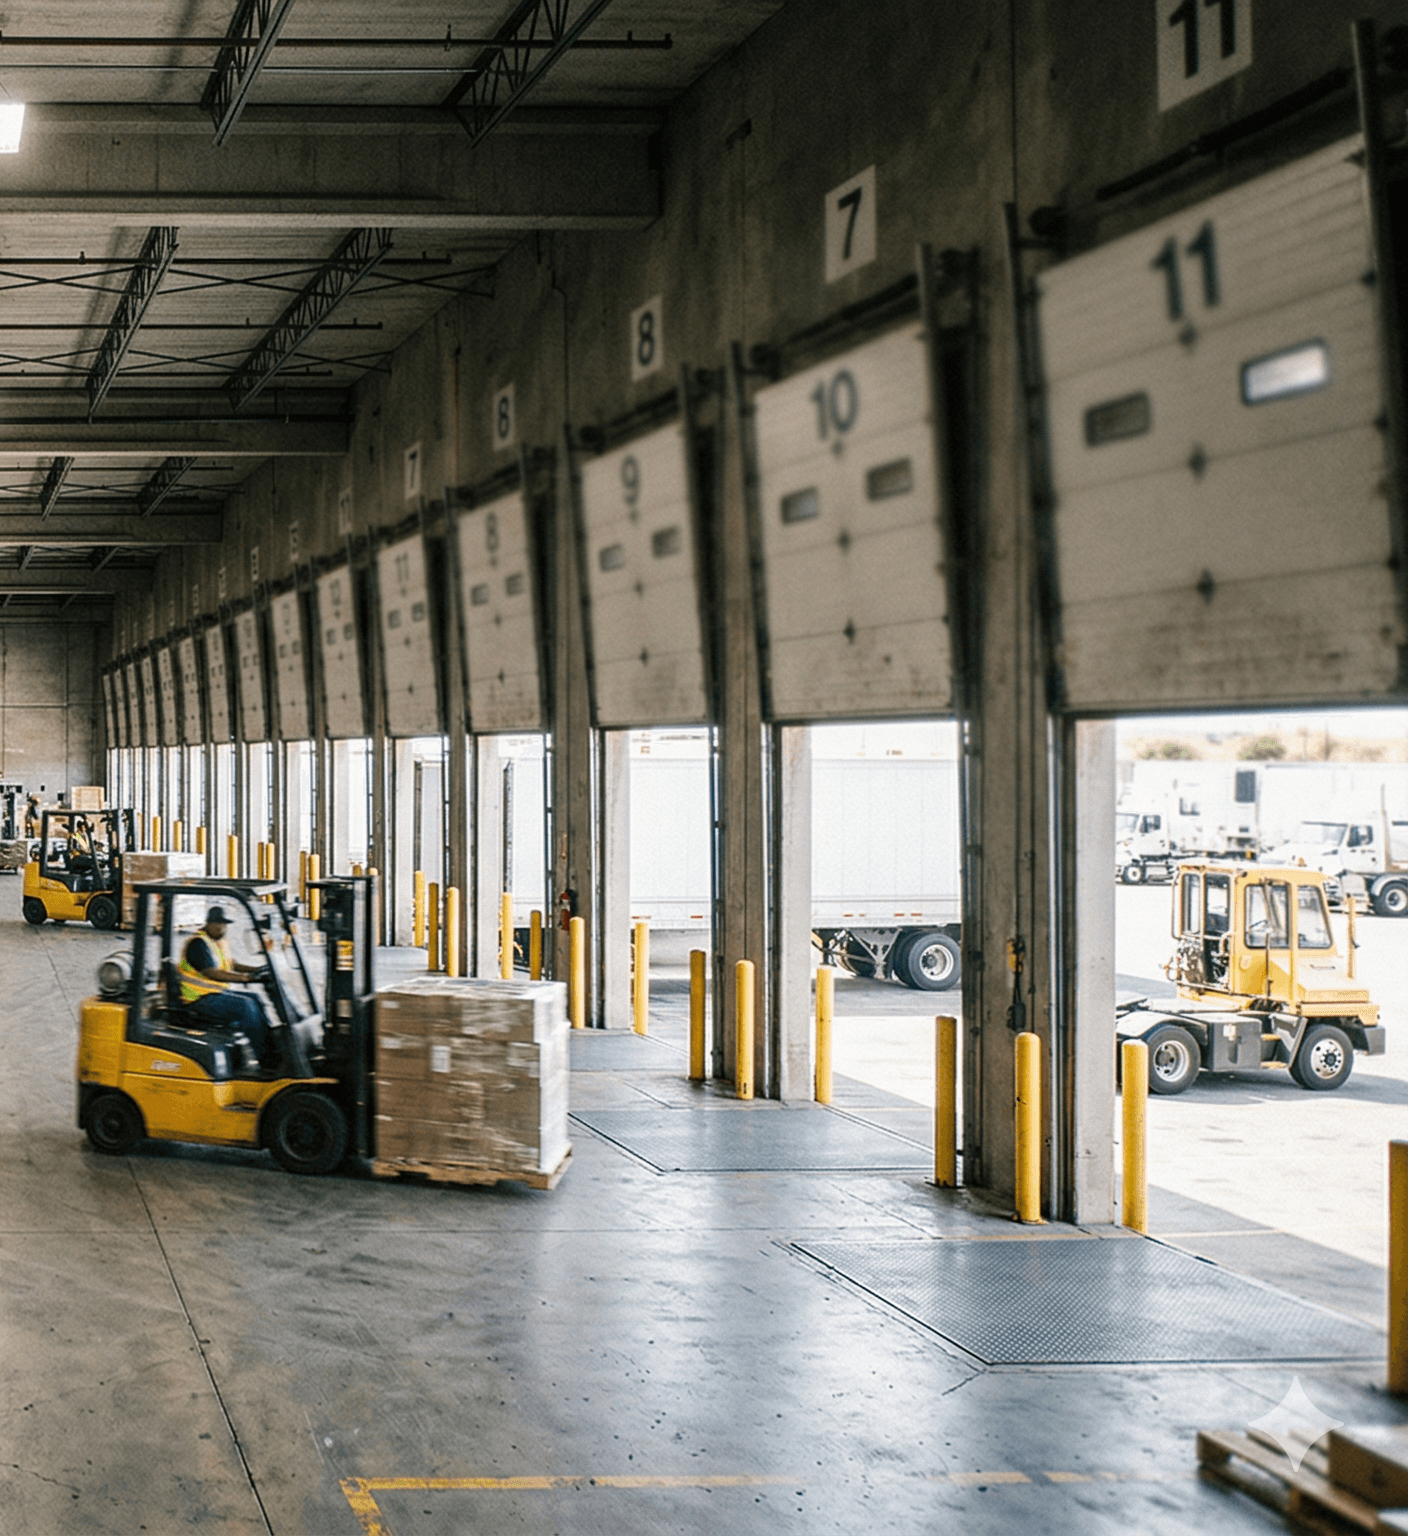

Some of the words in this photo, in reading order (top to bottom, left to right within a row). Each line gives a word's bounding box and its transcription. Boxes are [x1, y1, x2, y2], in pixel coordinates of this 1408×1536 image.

[1169, 0, 1235, 79] 11
[838, 186, 862, 260] 7
[1149, 220, 1220, 321] 11
[638, 310, 655, 367] 8
[498, 396, 510, 440] 8
[809, 370, 859, 441] 10
[621, 455, 640, 506] 9
